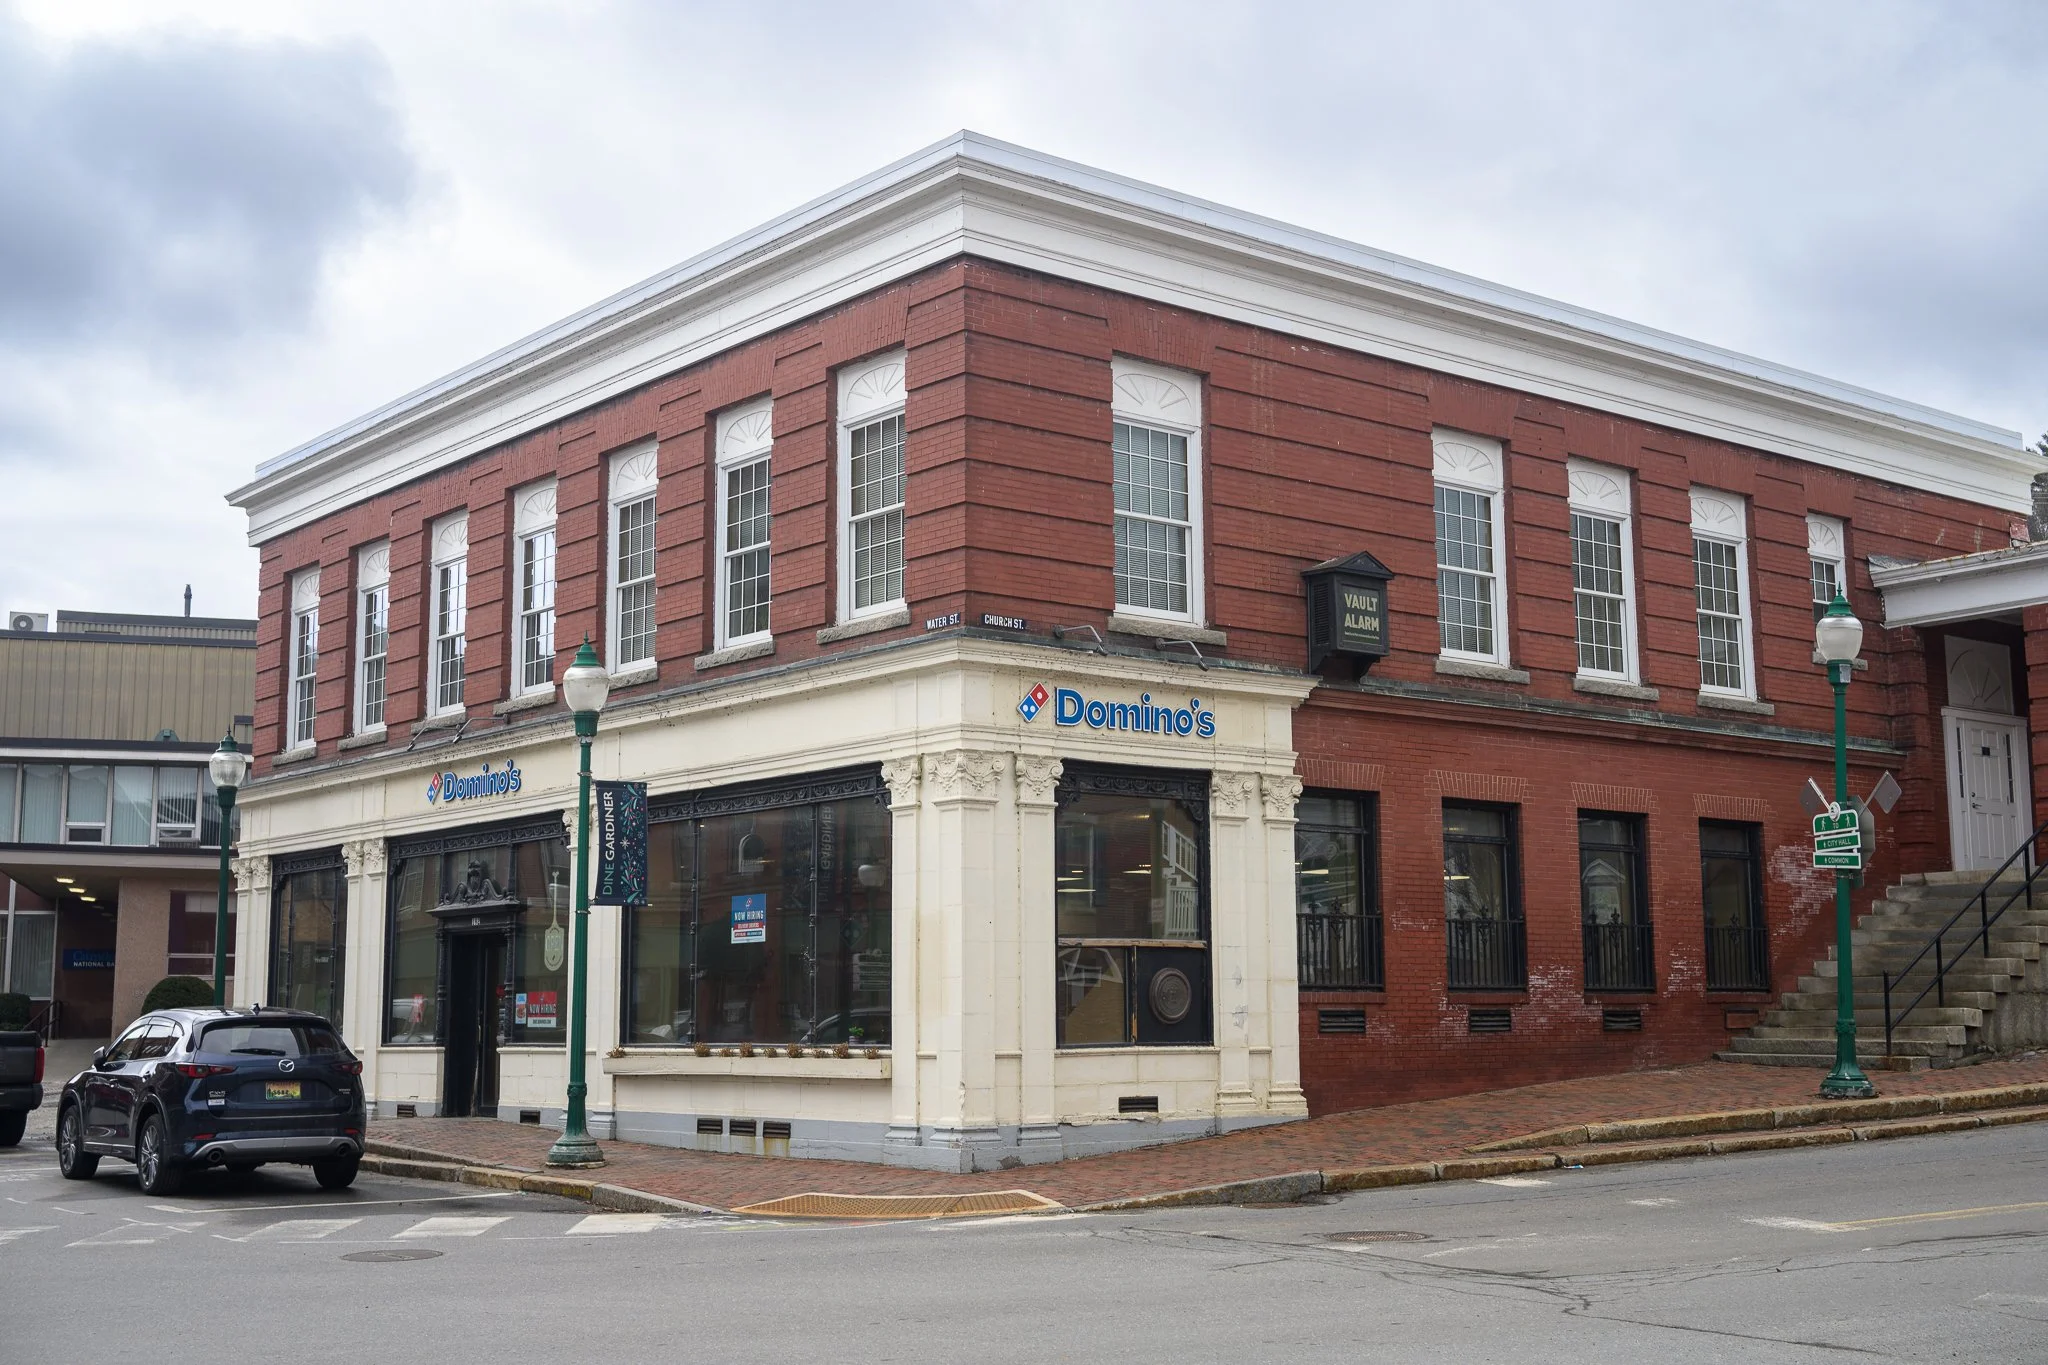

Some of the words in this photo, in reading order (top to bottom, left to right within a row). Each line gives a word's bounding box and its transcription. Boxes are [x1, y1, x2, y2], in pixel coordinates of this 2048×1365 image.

[1344, 593, 1378, 612] VAULT
[926, 616, 947, 629] WATER
[949, 613, 960, 625] ST.
[984, 614, 1012, 628] CHURCH
[1013, 618, 1024, 630] ST.
[1344, 613, 1379, 631] ALARM
[1055, 687, 1216, 738] Domino's
[443, 759, 521, 802] Domino's
[603, 791, 615, 861] GARDINER
[602, 863, 615, 895] DINE
[734, 911, 746, 921] NOW
[746, 910, 764, 920] HIRING
[529, 1003, 540, 1014] NOW
[540, 1003, 557, 1014] HIRING
